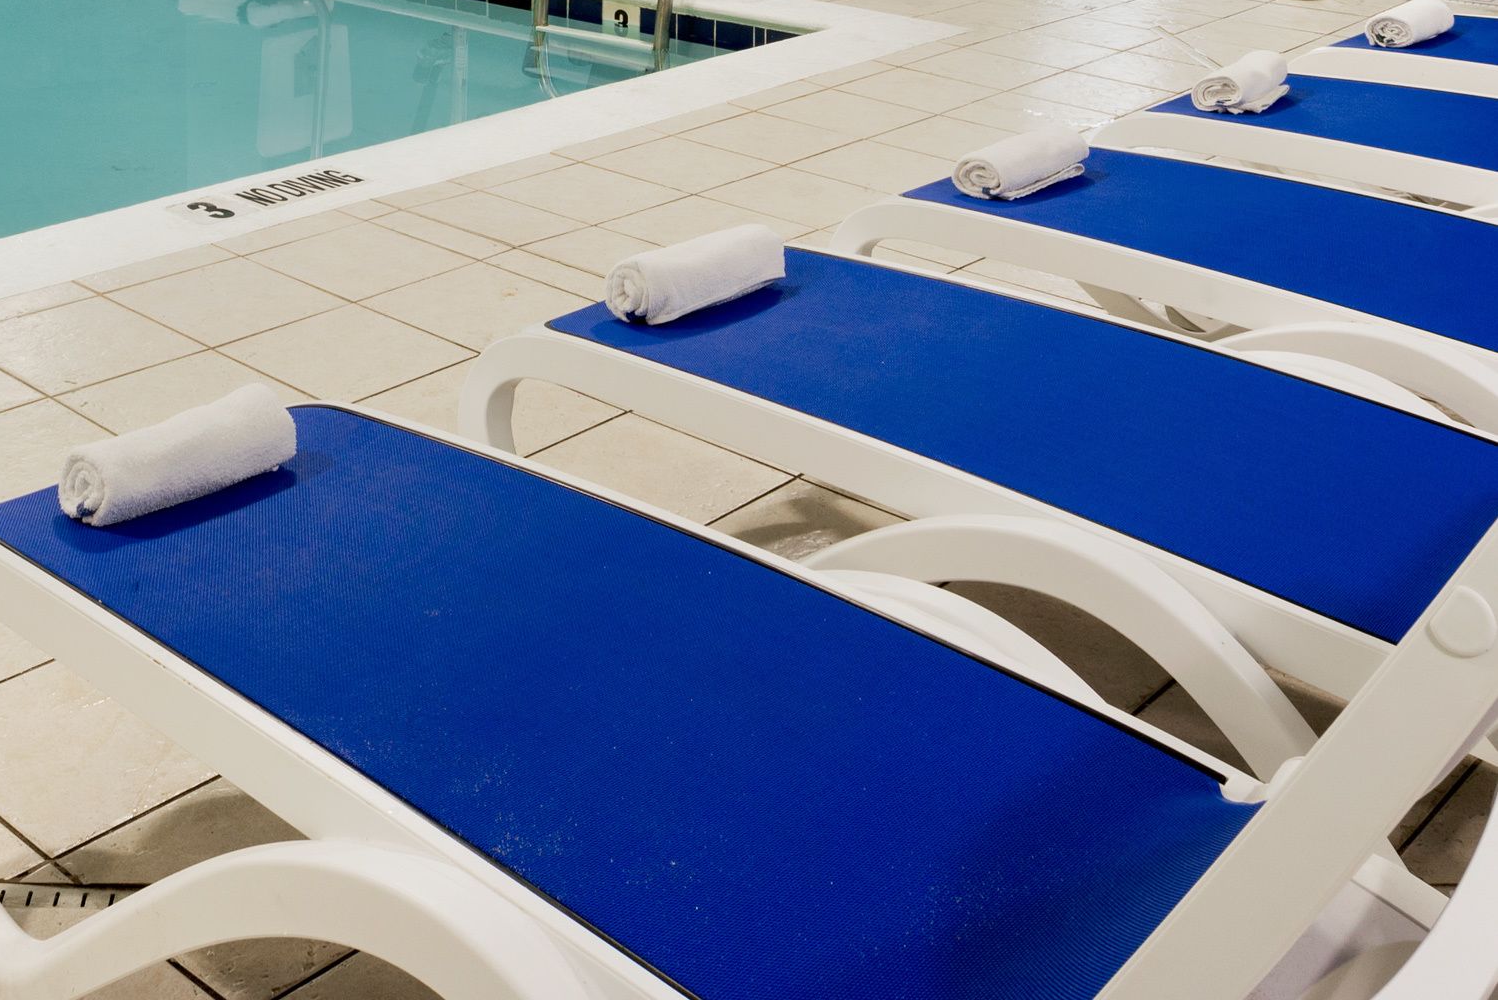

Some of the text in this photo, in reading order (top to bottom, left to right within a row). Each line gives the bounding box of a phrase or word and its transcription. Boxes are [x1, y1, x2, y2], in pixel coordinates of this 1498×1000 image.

[187, 169, 364, 219] 3 NO DIVING
